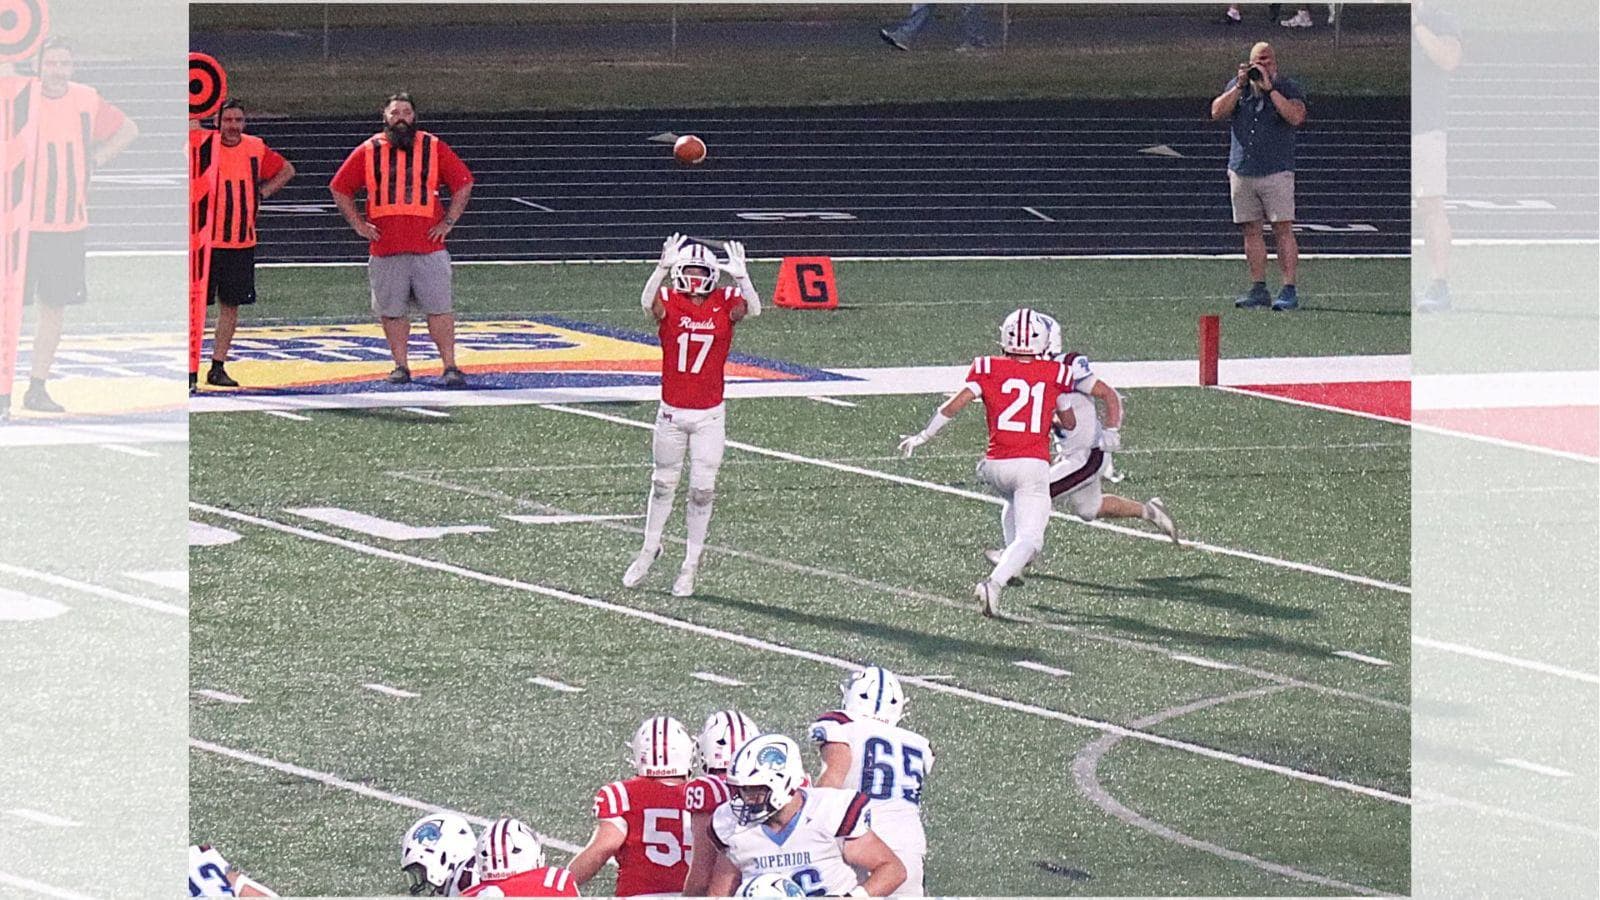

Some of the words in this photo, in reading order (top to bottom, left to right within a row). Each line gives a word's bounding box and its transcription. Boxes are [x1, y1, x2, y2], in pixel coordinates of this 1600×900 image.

[795, 264, 829, 302] G
[678, 316, 715, 332] Rapids
[677, 332, 715, 374] 17
[997, 378, 1046, 433] 21
[861, 737, 923, 805] 65
[685, 786, 705, 809] 69
[642, 808, 693, 867] 5
[753, 851, 811, 869] SUPERIOR
